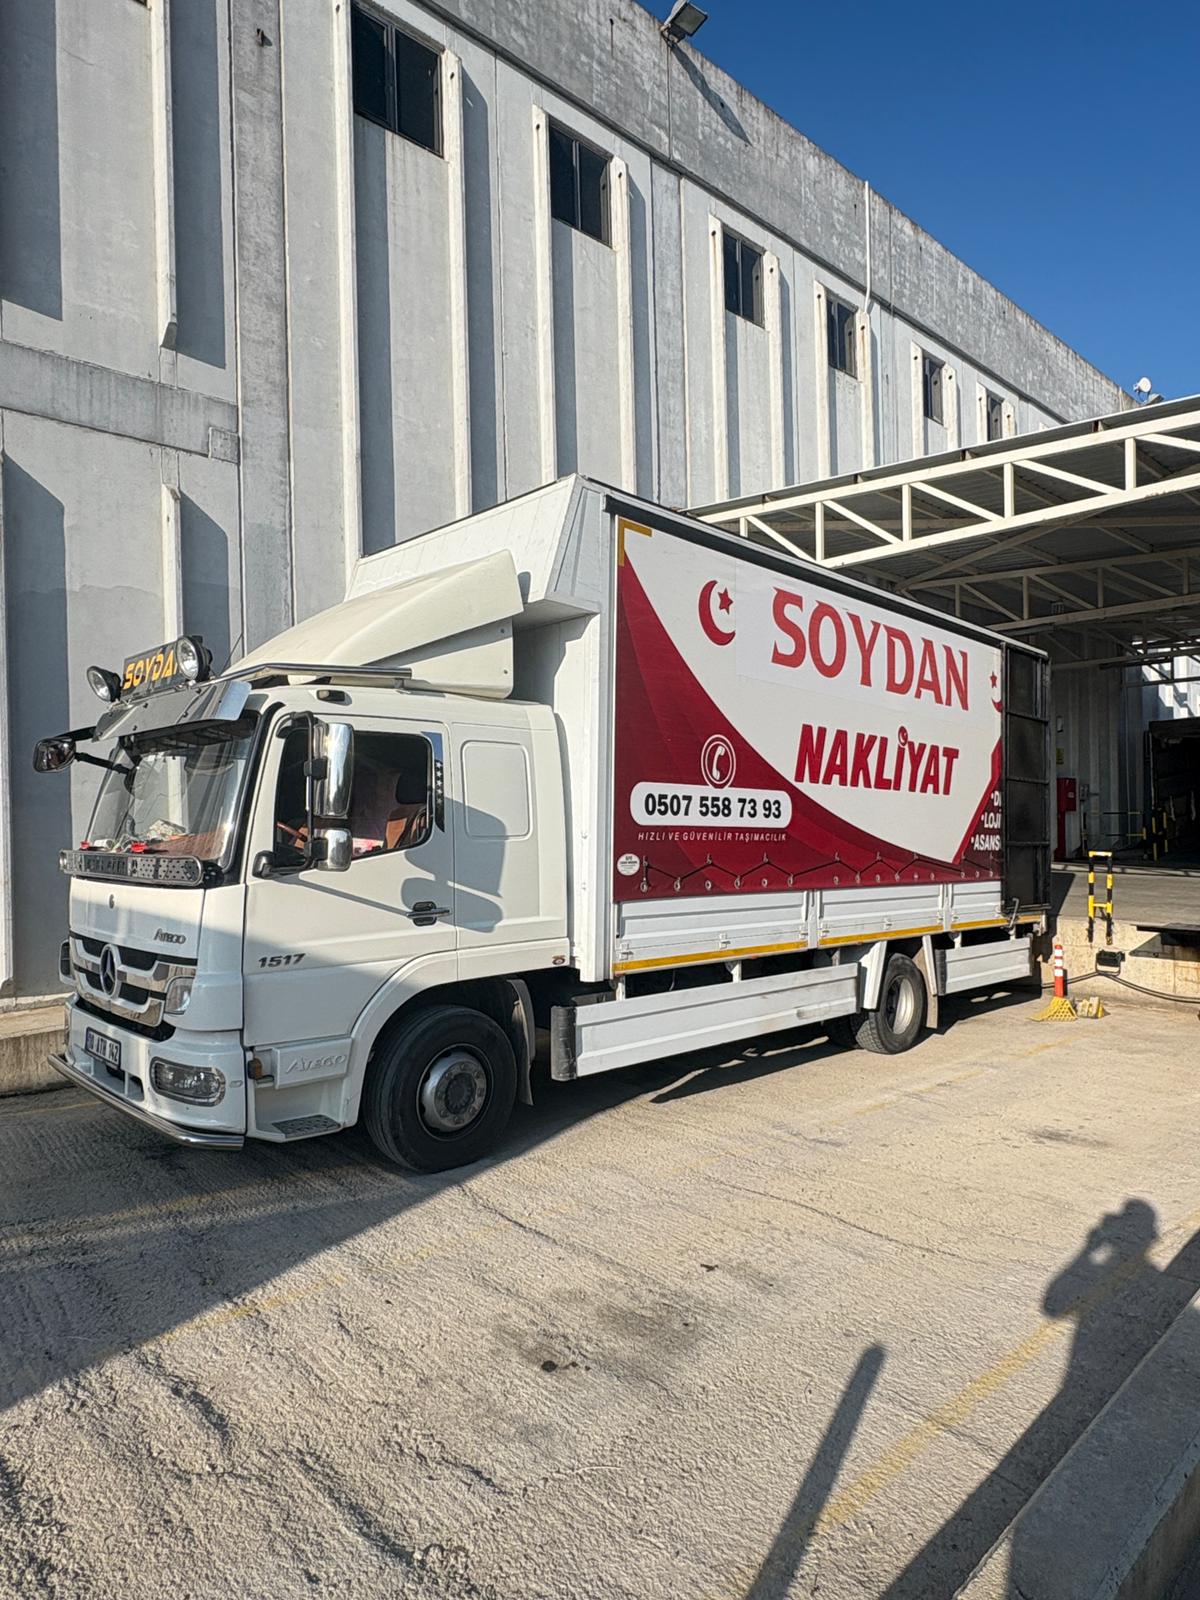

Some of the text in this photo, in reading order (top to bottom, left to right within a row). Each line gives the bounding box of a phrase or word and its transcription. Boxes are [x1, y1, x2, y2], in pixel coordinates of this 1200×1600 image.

[771, 586, 969, 711] SOYDAN
[123, 648, 178, 690] SOYDA
[794, 723, 960, 796] NAKLİYAT
[644, 793, 782, 819] 0507 558 73 93
[638, 831, 666, 841] HIZLI
[668, 831, 680, 841] VE
[682, 830, 733, 842] GÜVENİLİR
[973, 834, 1002, 851] ASANS
[258, 953, 306, 969] 1517
